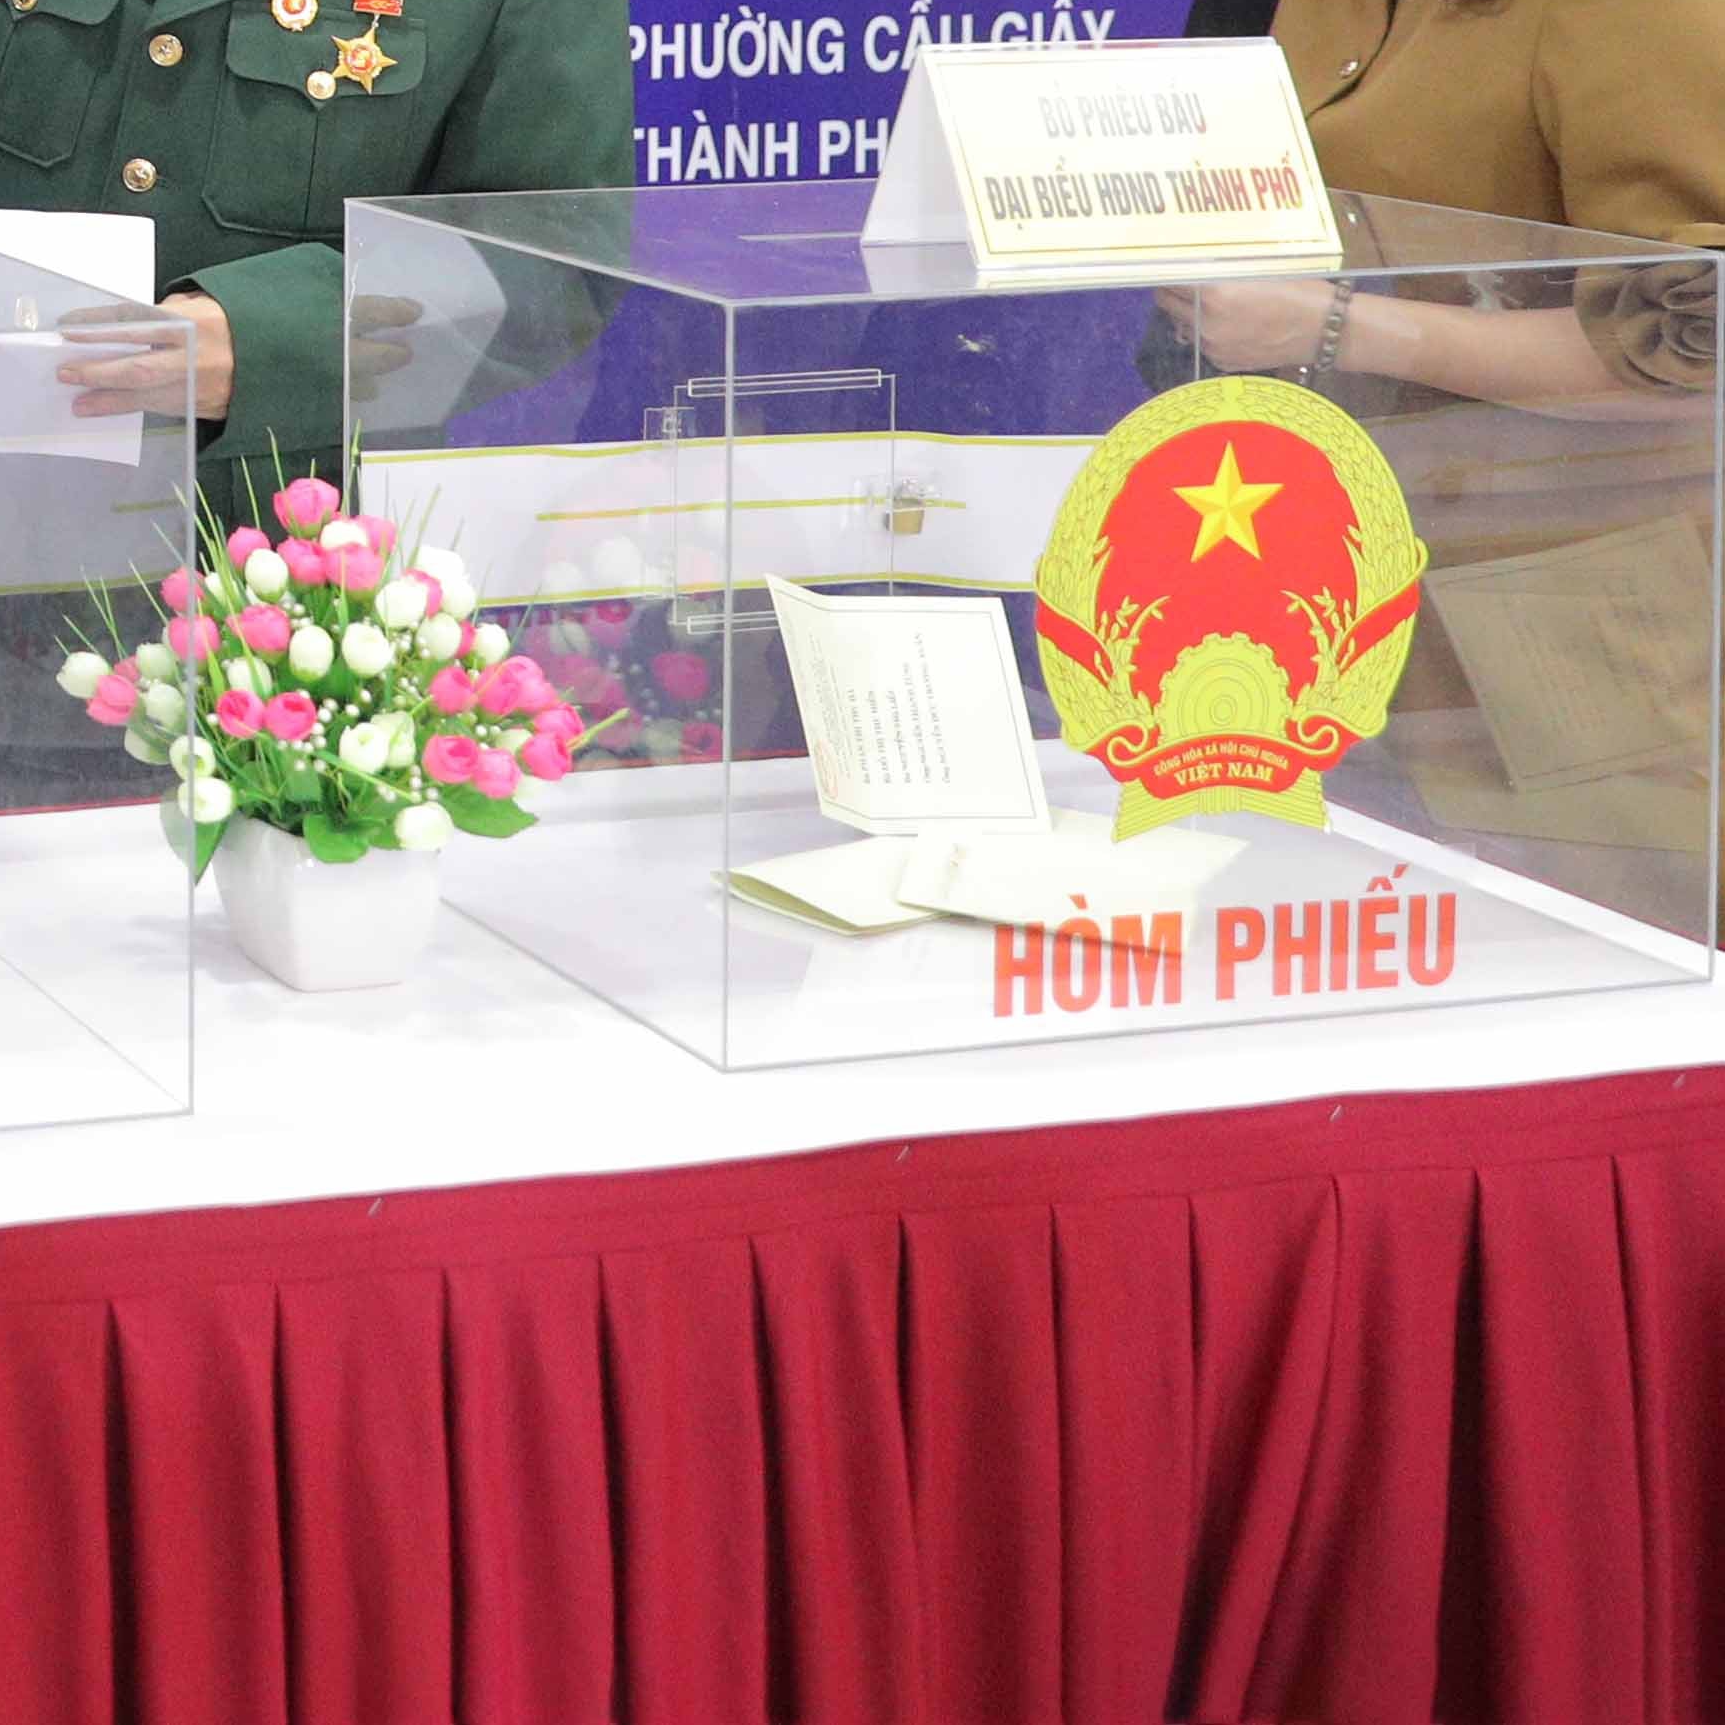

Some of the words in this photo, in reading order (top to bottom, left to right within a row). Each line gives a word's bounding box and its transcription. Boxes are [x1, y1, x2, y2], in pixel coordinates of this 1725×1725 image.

[633, 109, 798, 182] HÀNH
[818, 118, 888, 175] PH
[985, 177, 1032, 230] ĐẠI
[1098, 173, 1166, 215] HĐND
[1167, 161, 1251, 213] THÀNH
[1251, 152, 1302, 211] PHỐ
[1174, 761, 1223, 786] VIỆT
[1227, 762, 1273, 783] NAM
[993, 895, 1182, 1018] HÒM
[1215, 864, 1457, 1003] PHIẾU
